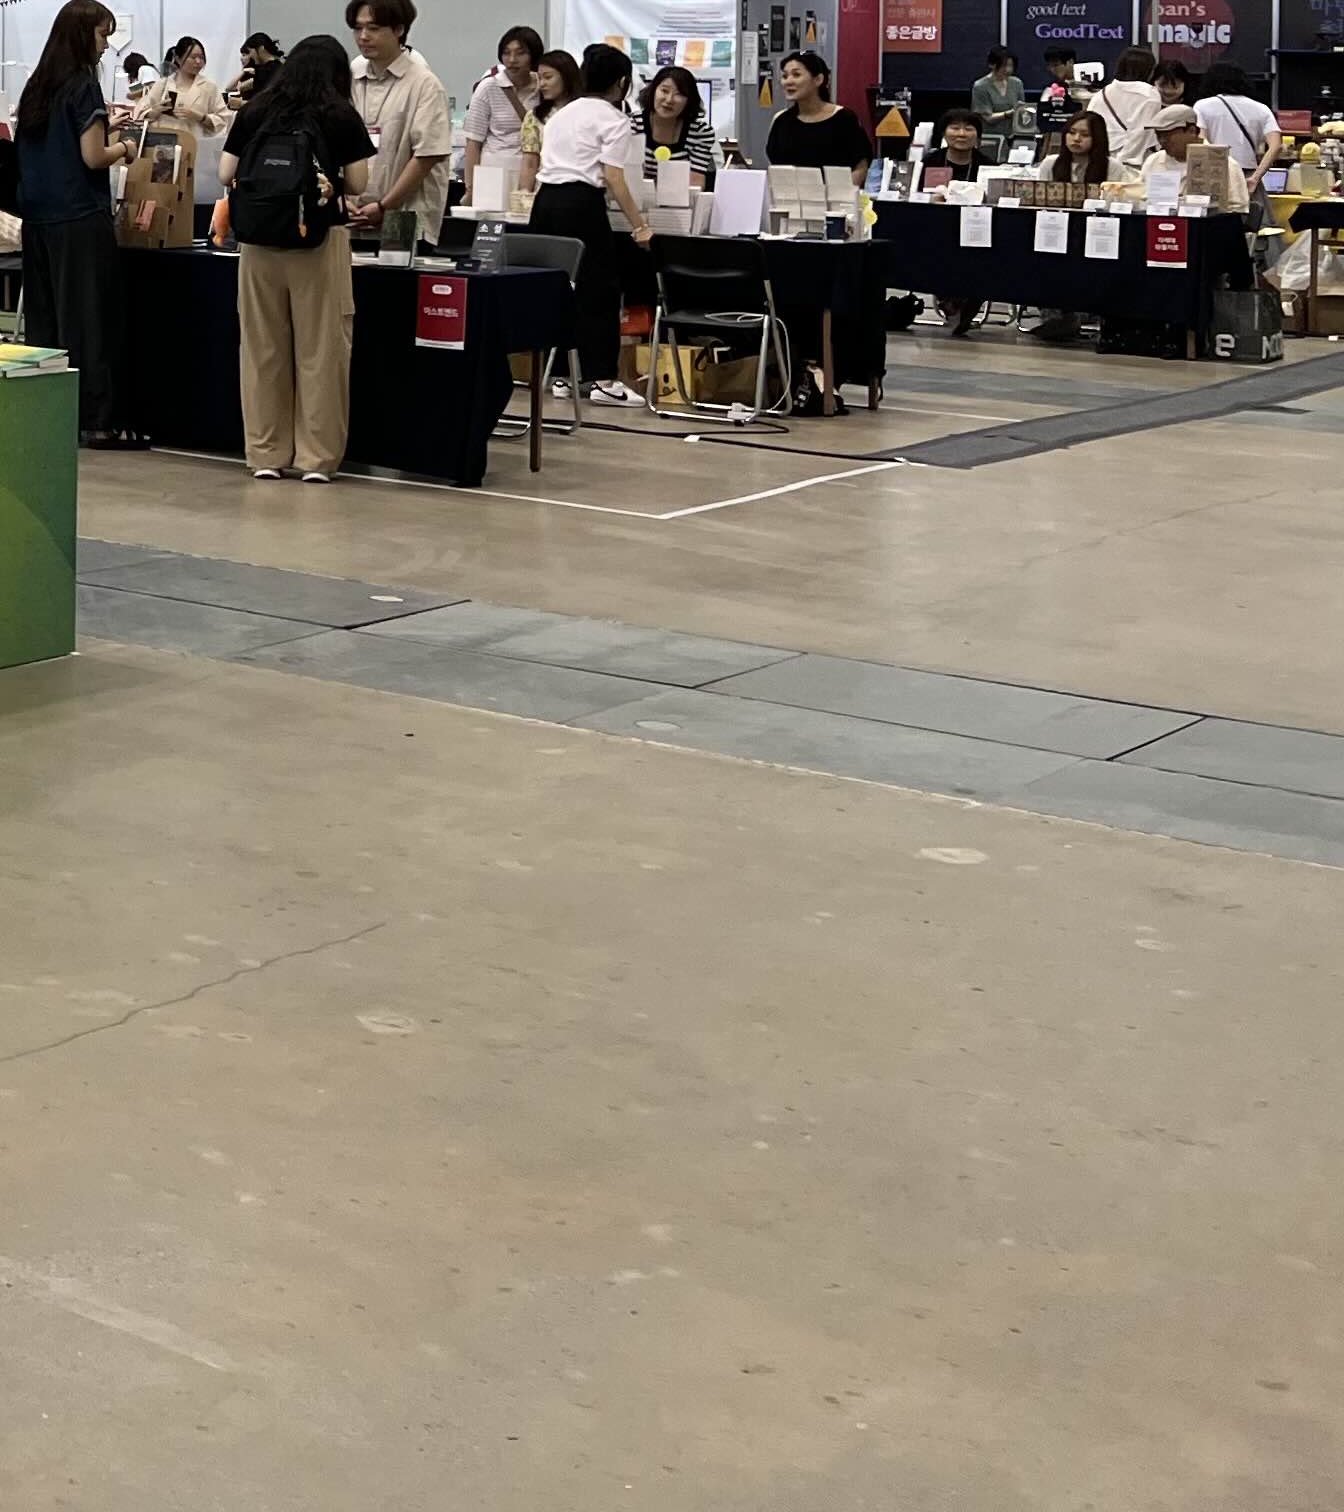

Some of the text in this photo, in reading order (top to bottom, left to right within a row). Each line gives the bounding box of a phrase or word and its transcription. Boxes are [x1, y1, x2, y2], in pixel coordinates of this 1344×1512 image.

[1026, 3, 1086, 20] good text
[885, 25, 938, 41] 좋은글방
[1034, 22, 1124, 39] GoodText
